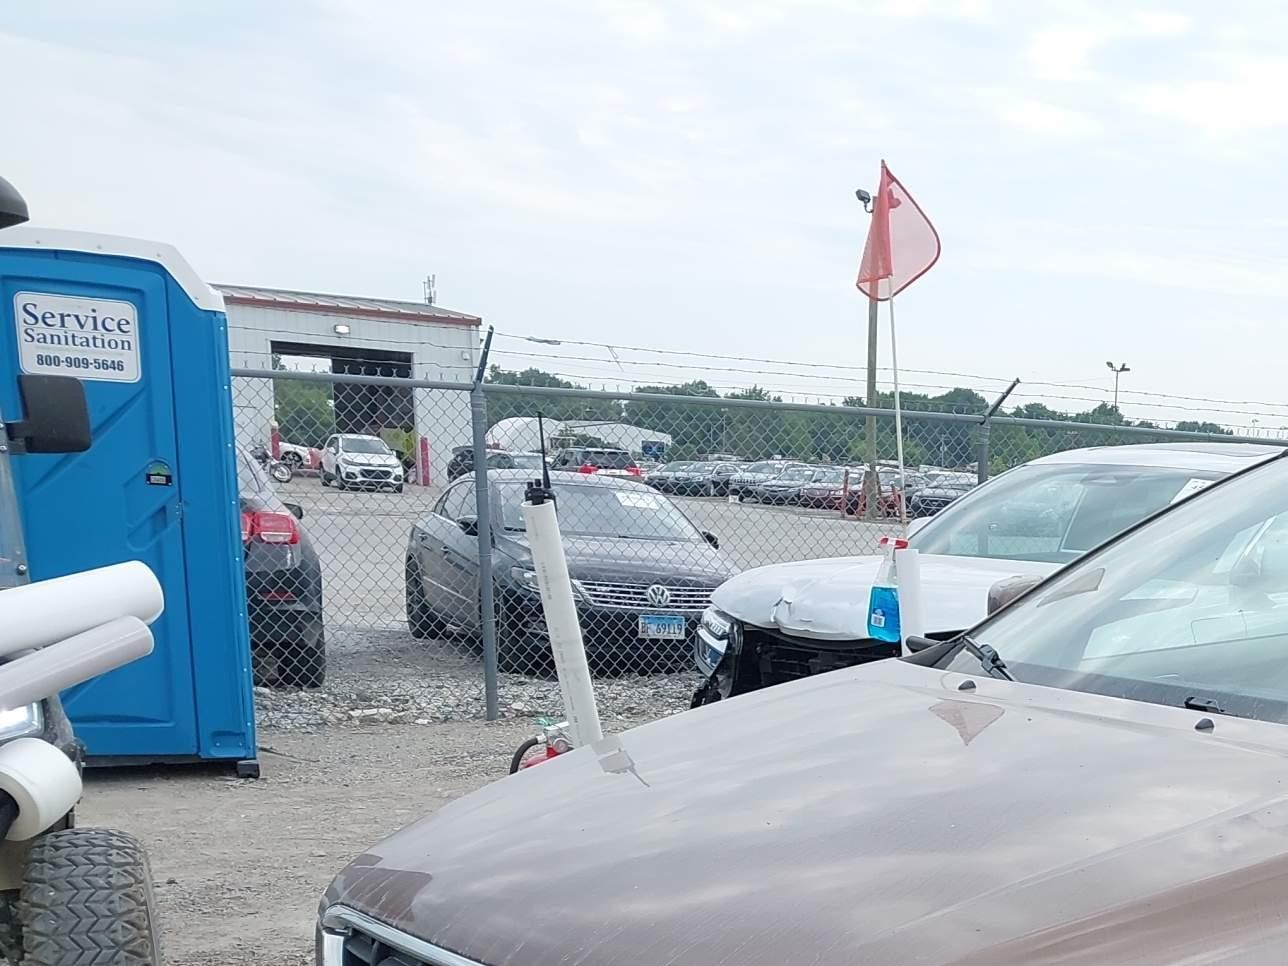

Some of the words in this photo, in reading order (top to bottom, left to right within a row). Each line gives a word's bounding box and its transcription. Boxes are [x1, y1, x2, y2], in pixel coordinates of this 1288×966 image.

[22, 303, 131, 334] Service
[23, 328, 131, 350] Sanitation
[36, 354, 125, 371] 800-909-5646
[656, 623, 683, 634] 69119
